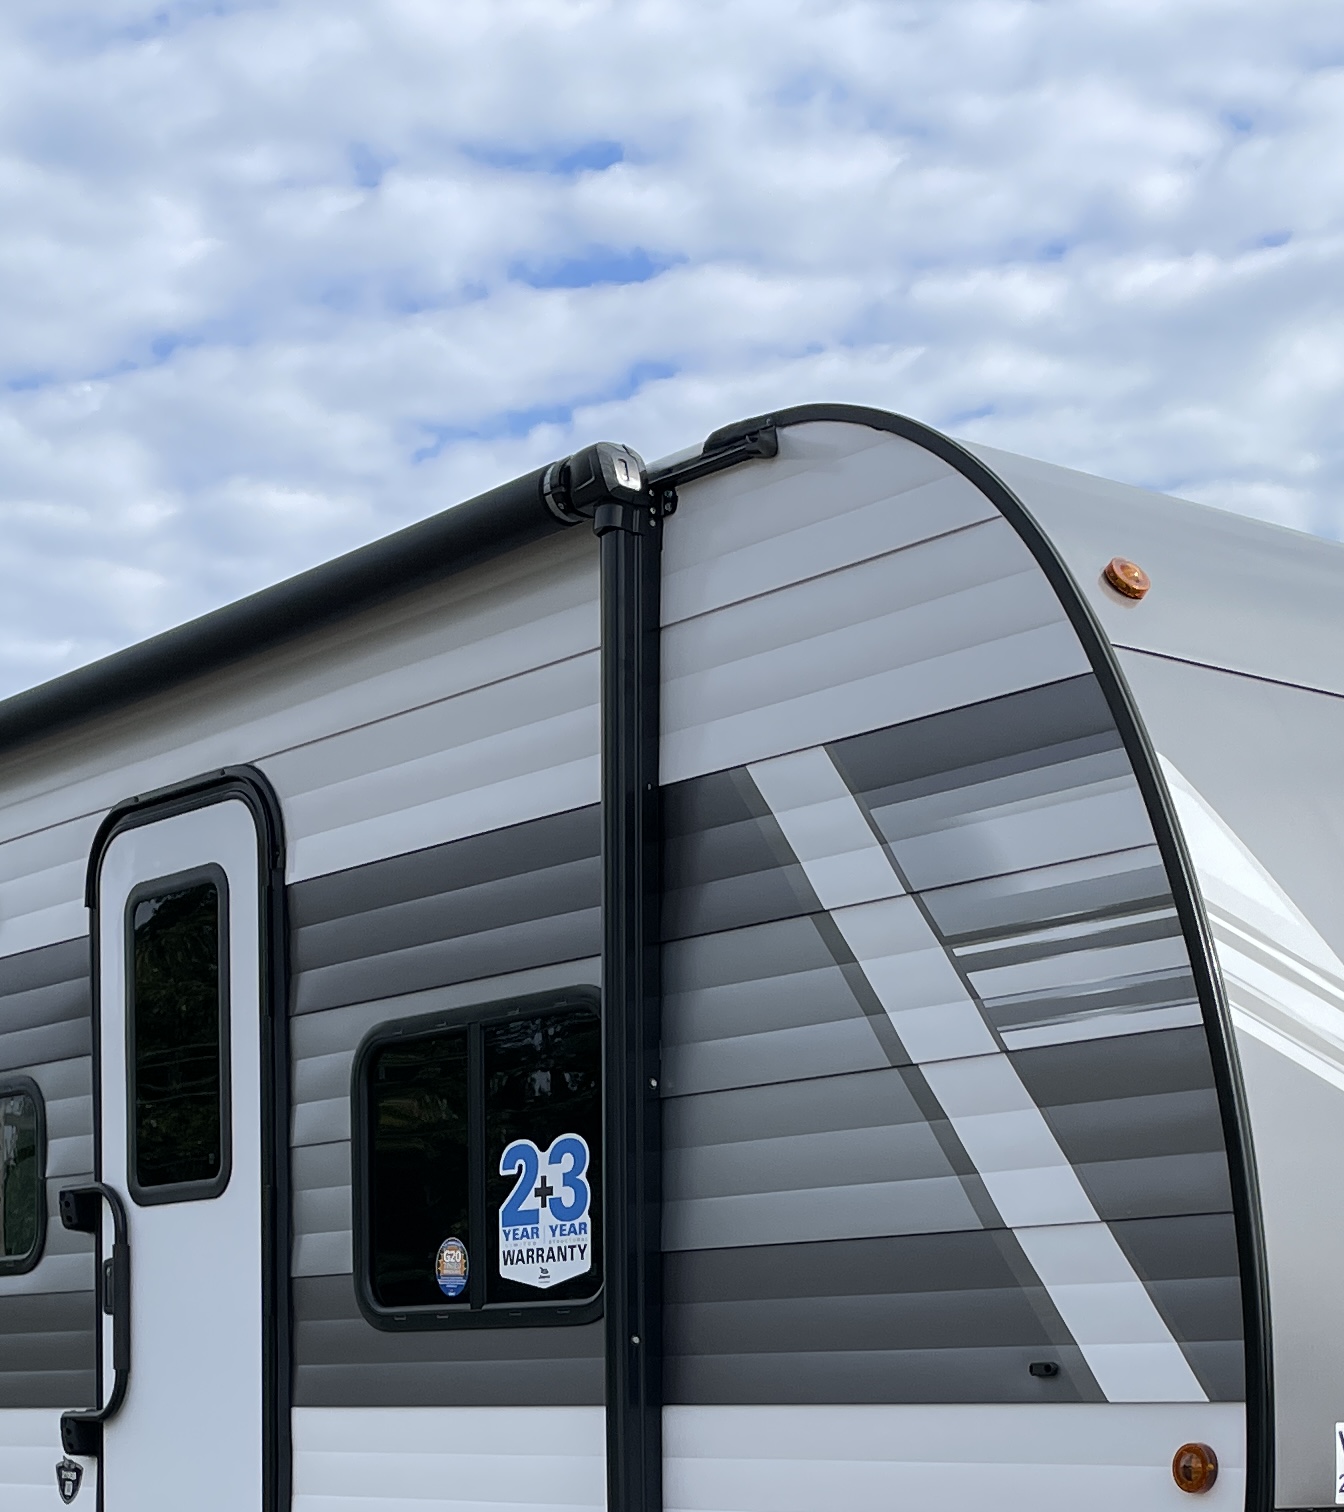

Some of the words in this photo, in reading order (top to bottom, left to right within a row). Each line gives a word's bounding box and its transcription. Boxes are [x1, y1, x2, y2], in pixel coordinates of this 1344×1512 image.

[502, 1226, 540, 1242] YEAR
[548, 1221, 588, 1238] YEAR
[502, 1243, 588, 1266] WARRANTY
